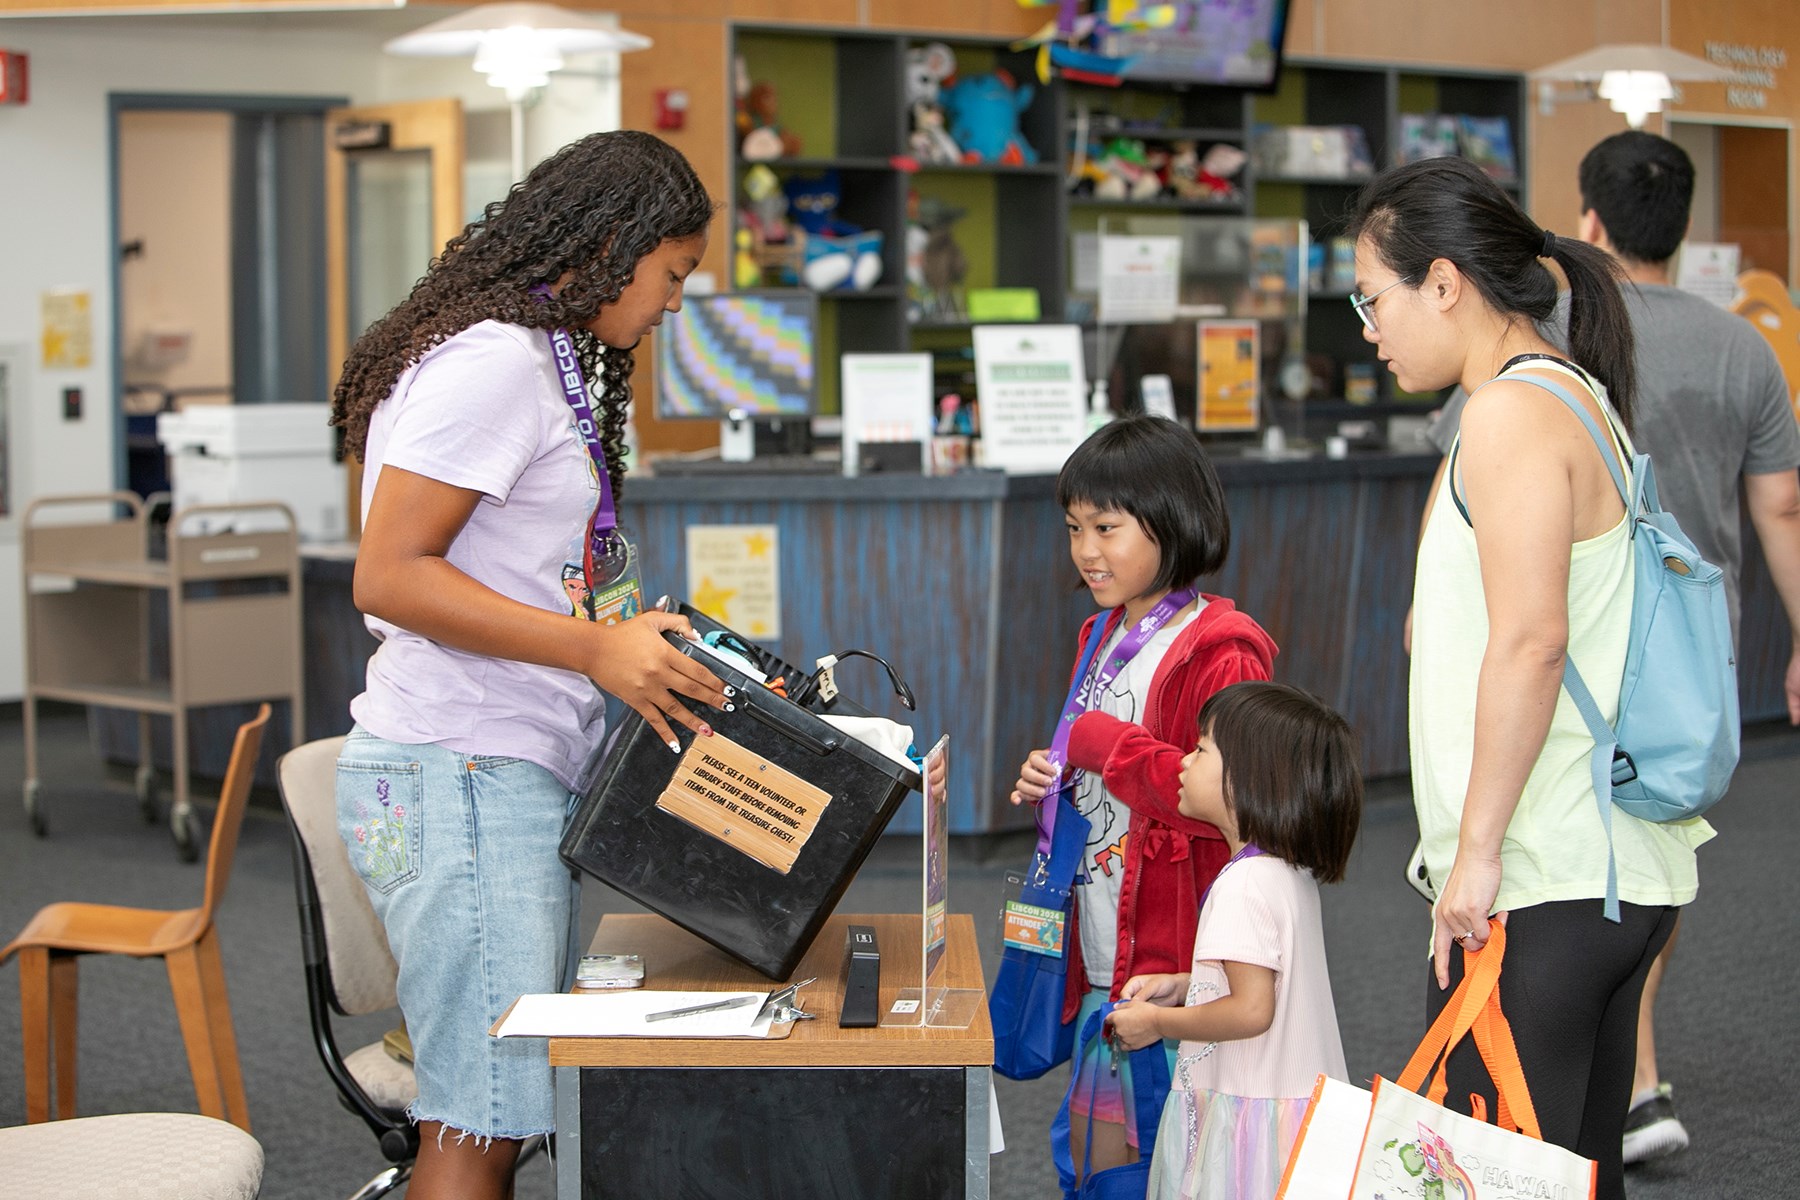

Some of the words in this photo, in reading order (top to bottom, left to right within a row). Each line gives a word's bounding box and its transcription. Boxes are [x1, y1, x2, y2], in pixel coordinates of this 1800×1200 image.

[684, 779, 707, 795] ITEMS
[705, 790, 727, 806] FROM
[725, 801, 740, 813] THE
[738, 807, 772, 831] TREASURE
[770, 826, 796, 844] CHEST!
[693, 766, 723, 786] LIBRARY
[720, 781, 743, 797] STAFF
[739, 792, 767, 811] BEFORE
[764, 806, 801, 830] REMOVING
[701, 754, 727, 772] PLEASE
[724, 767, 740, 779] SEE
[736, 774, 745, 783] A
[743, 777, 762, 791] TEEN
[759, 785, 797, 810] VOLUNTEER
[794, 806, 807, 816] OR
[1007, 915, 1042, 930] ATTENDEE
[1011, 903, 1040, 916] LIBCON
[1040, 910, 1060, 920] 2024
